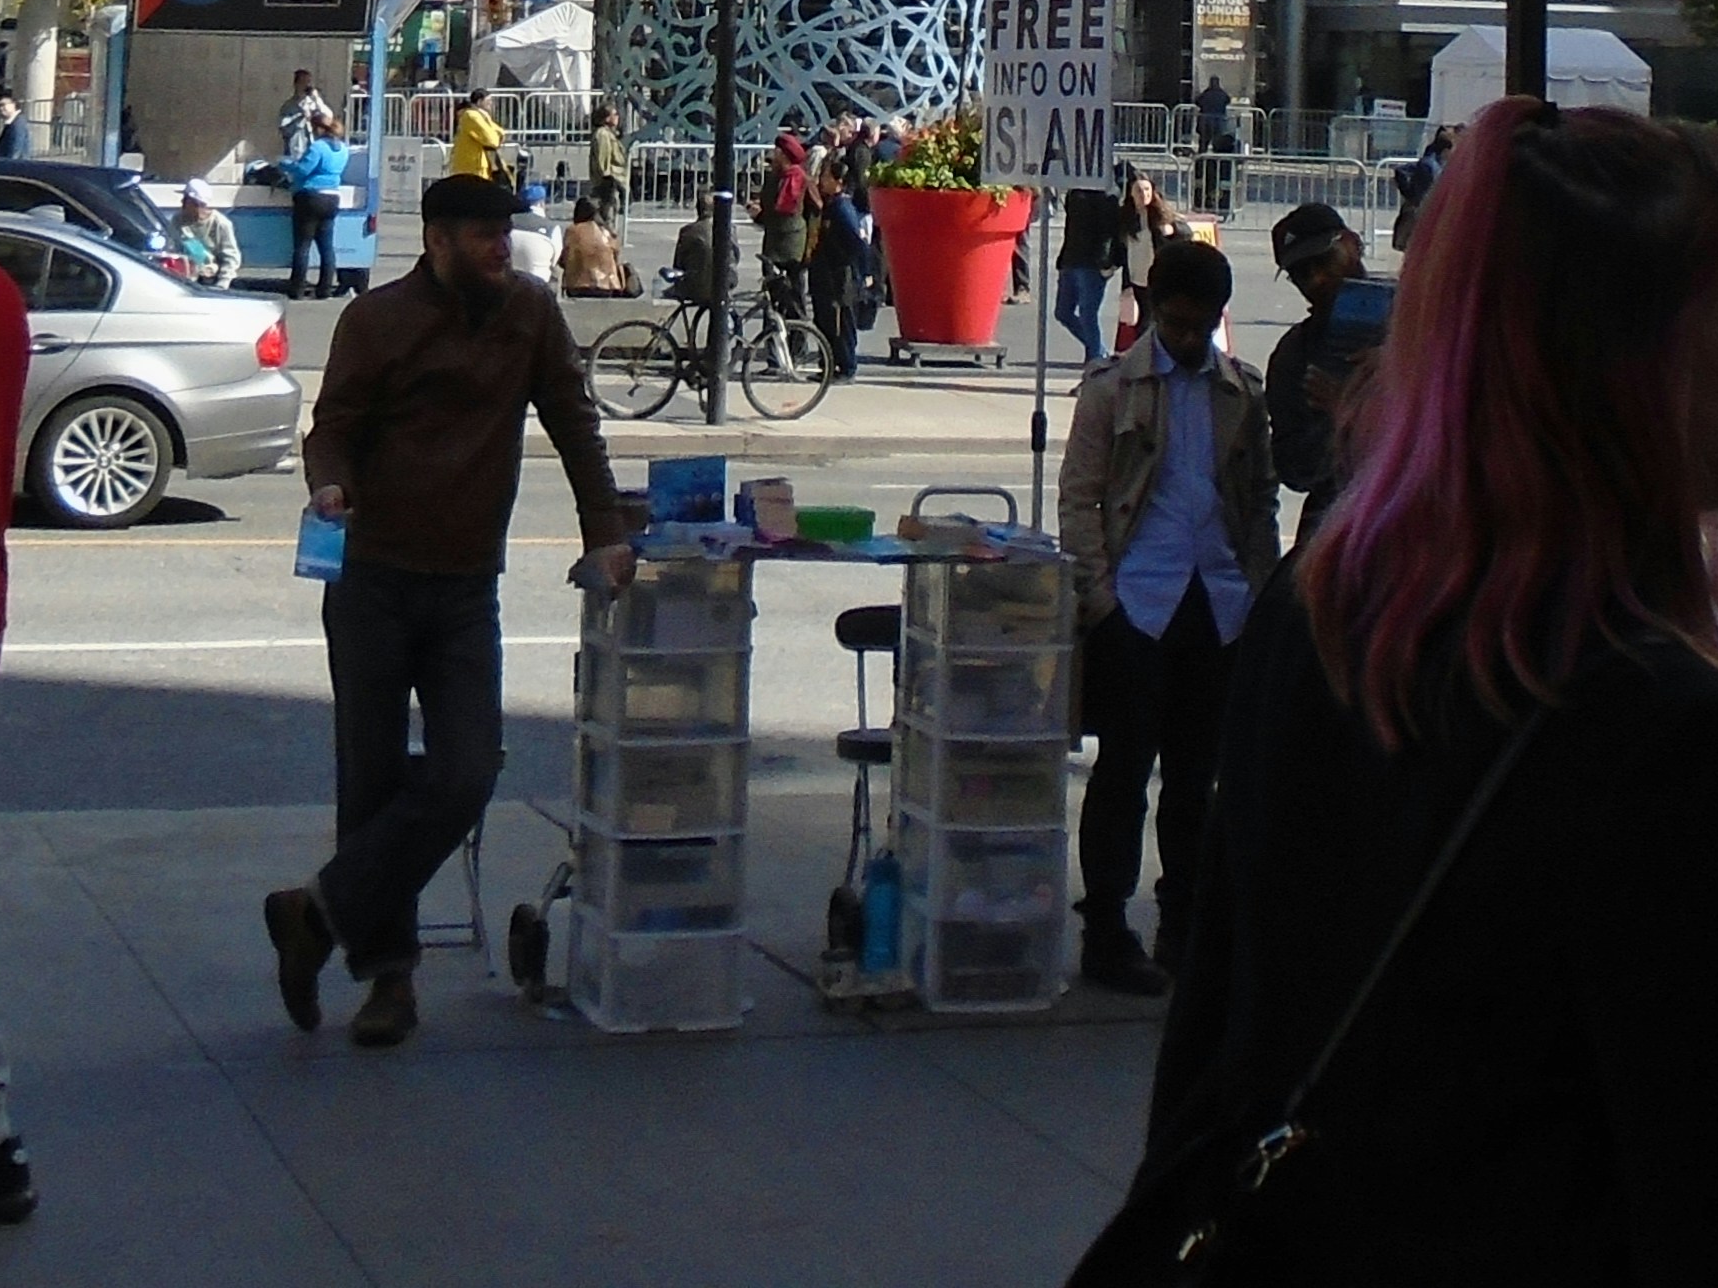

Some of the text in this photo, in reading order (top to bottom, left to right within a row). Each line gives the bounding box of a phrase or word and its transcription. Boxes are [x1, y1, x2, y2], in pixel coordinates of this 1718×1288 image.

[1196, 5, 1250, 16] DUNDAS
[993, 61, 1097, 97] INFO ON
[985, 106, 1104, 178] ISLAM
